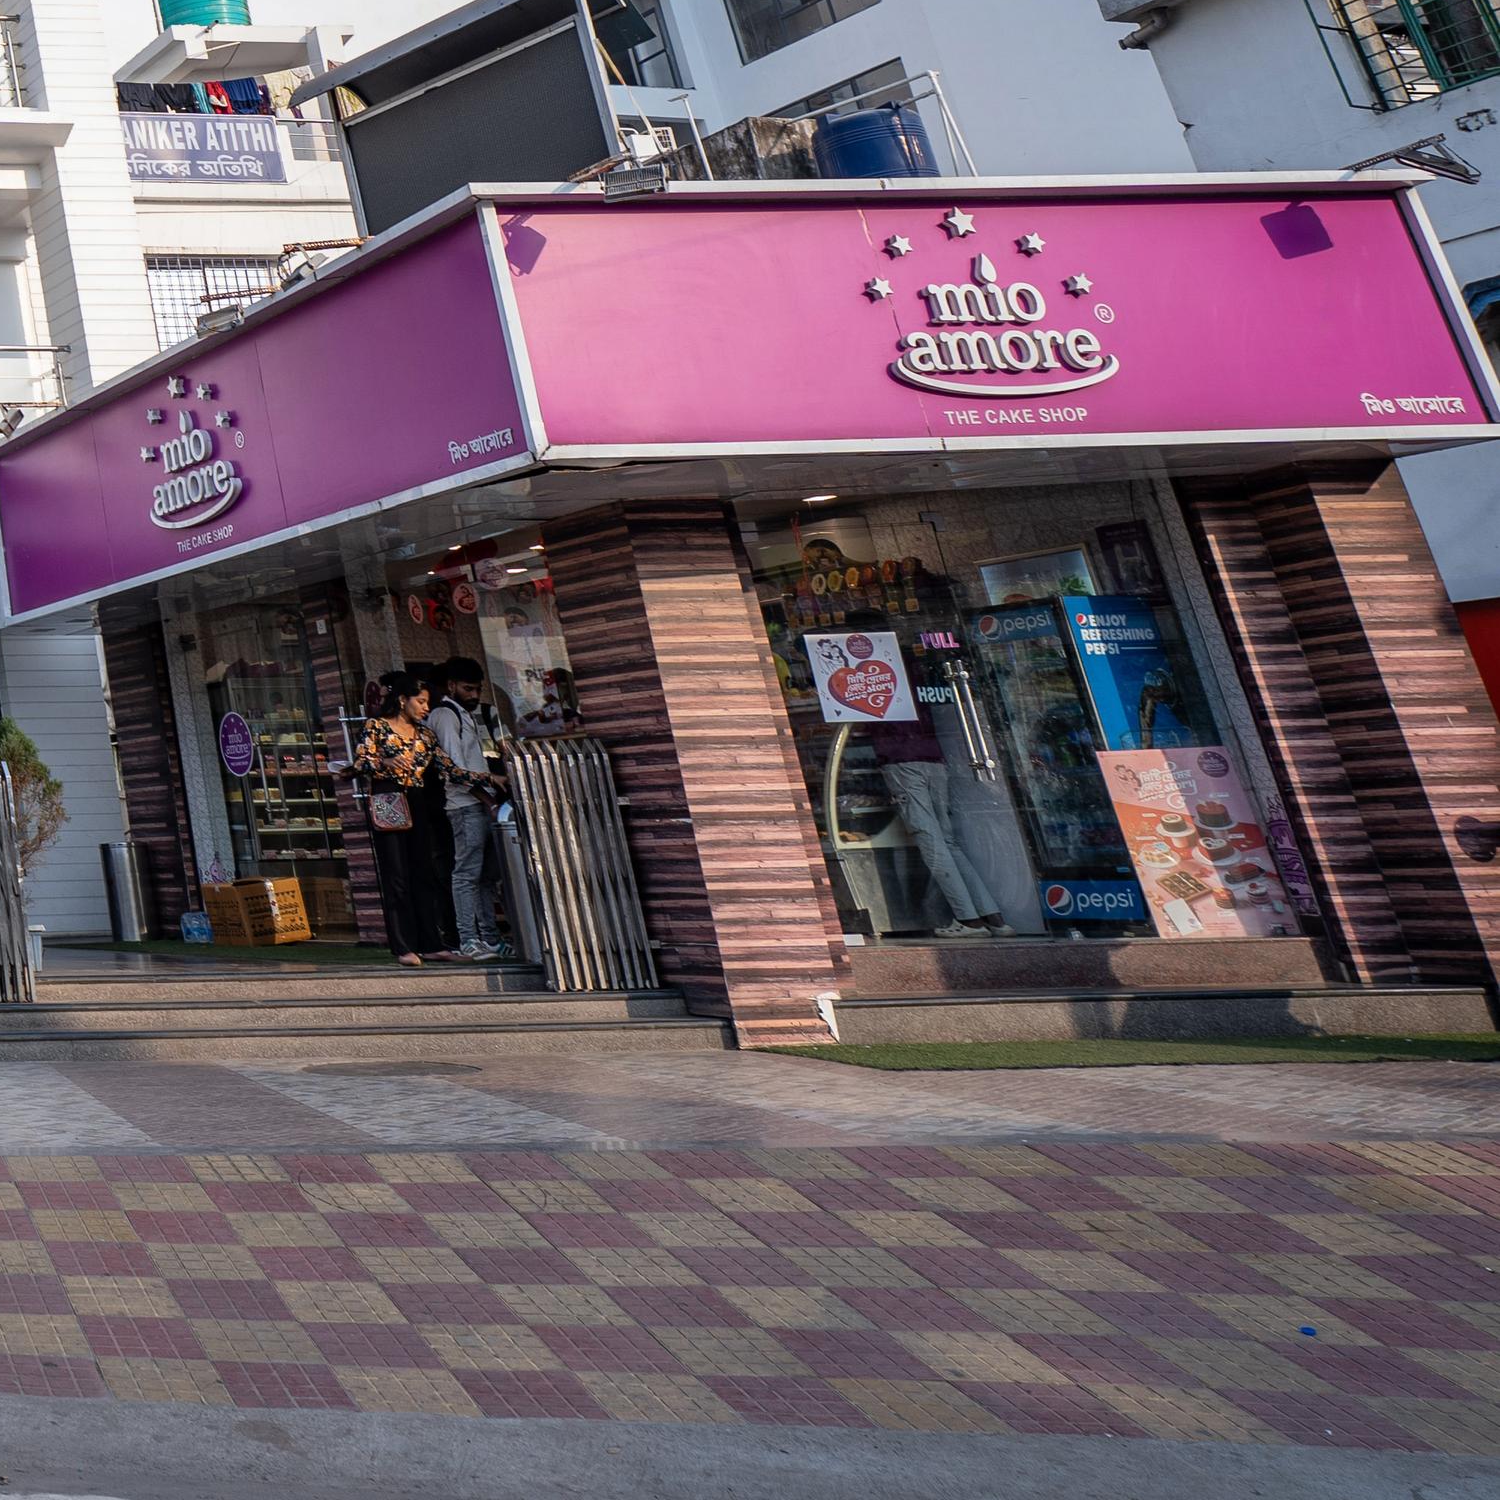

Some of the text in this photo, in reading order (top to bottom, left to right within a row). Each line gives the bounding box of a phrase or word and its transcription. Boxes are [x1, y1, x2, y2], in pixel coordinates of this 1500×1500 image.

[206, 122, 275, 151] ATITHI
[198, 155, 264, 176] অতিথি
[925, 254, 1047, 322] mio
[904, 328, 1103, 372] amore
[1360, 392, 1466, 415] মিও আমোরে
[944, 407, 1088, 426] THE CAKE SHOP
[160, 411, 210, 474] mio
[448, 428, 514, 464] মিও আমোরে
[153, 460, 232, 516] amore
[177, 524, 234, 553] THE CAKE SHOP
[1003, 611, 1052, 635] pepsi
[1086, 614, 1127, 627] ENJOY
[919, 632, 961, 650] PULL
[1080, 628, 1155, 641] REFRESHING
[1085, 642, 1120, 656] PEPSI
[867, 682, 894, 695] story
[228, 730, 243, 745] mio
[1076, 888, 1135, 913] pepsi
